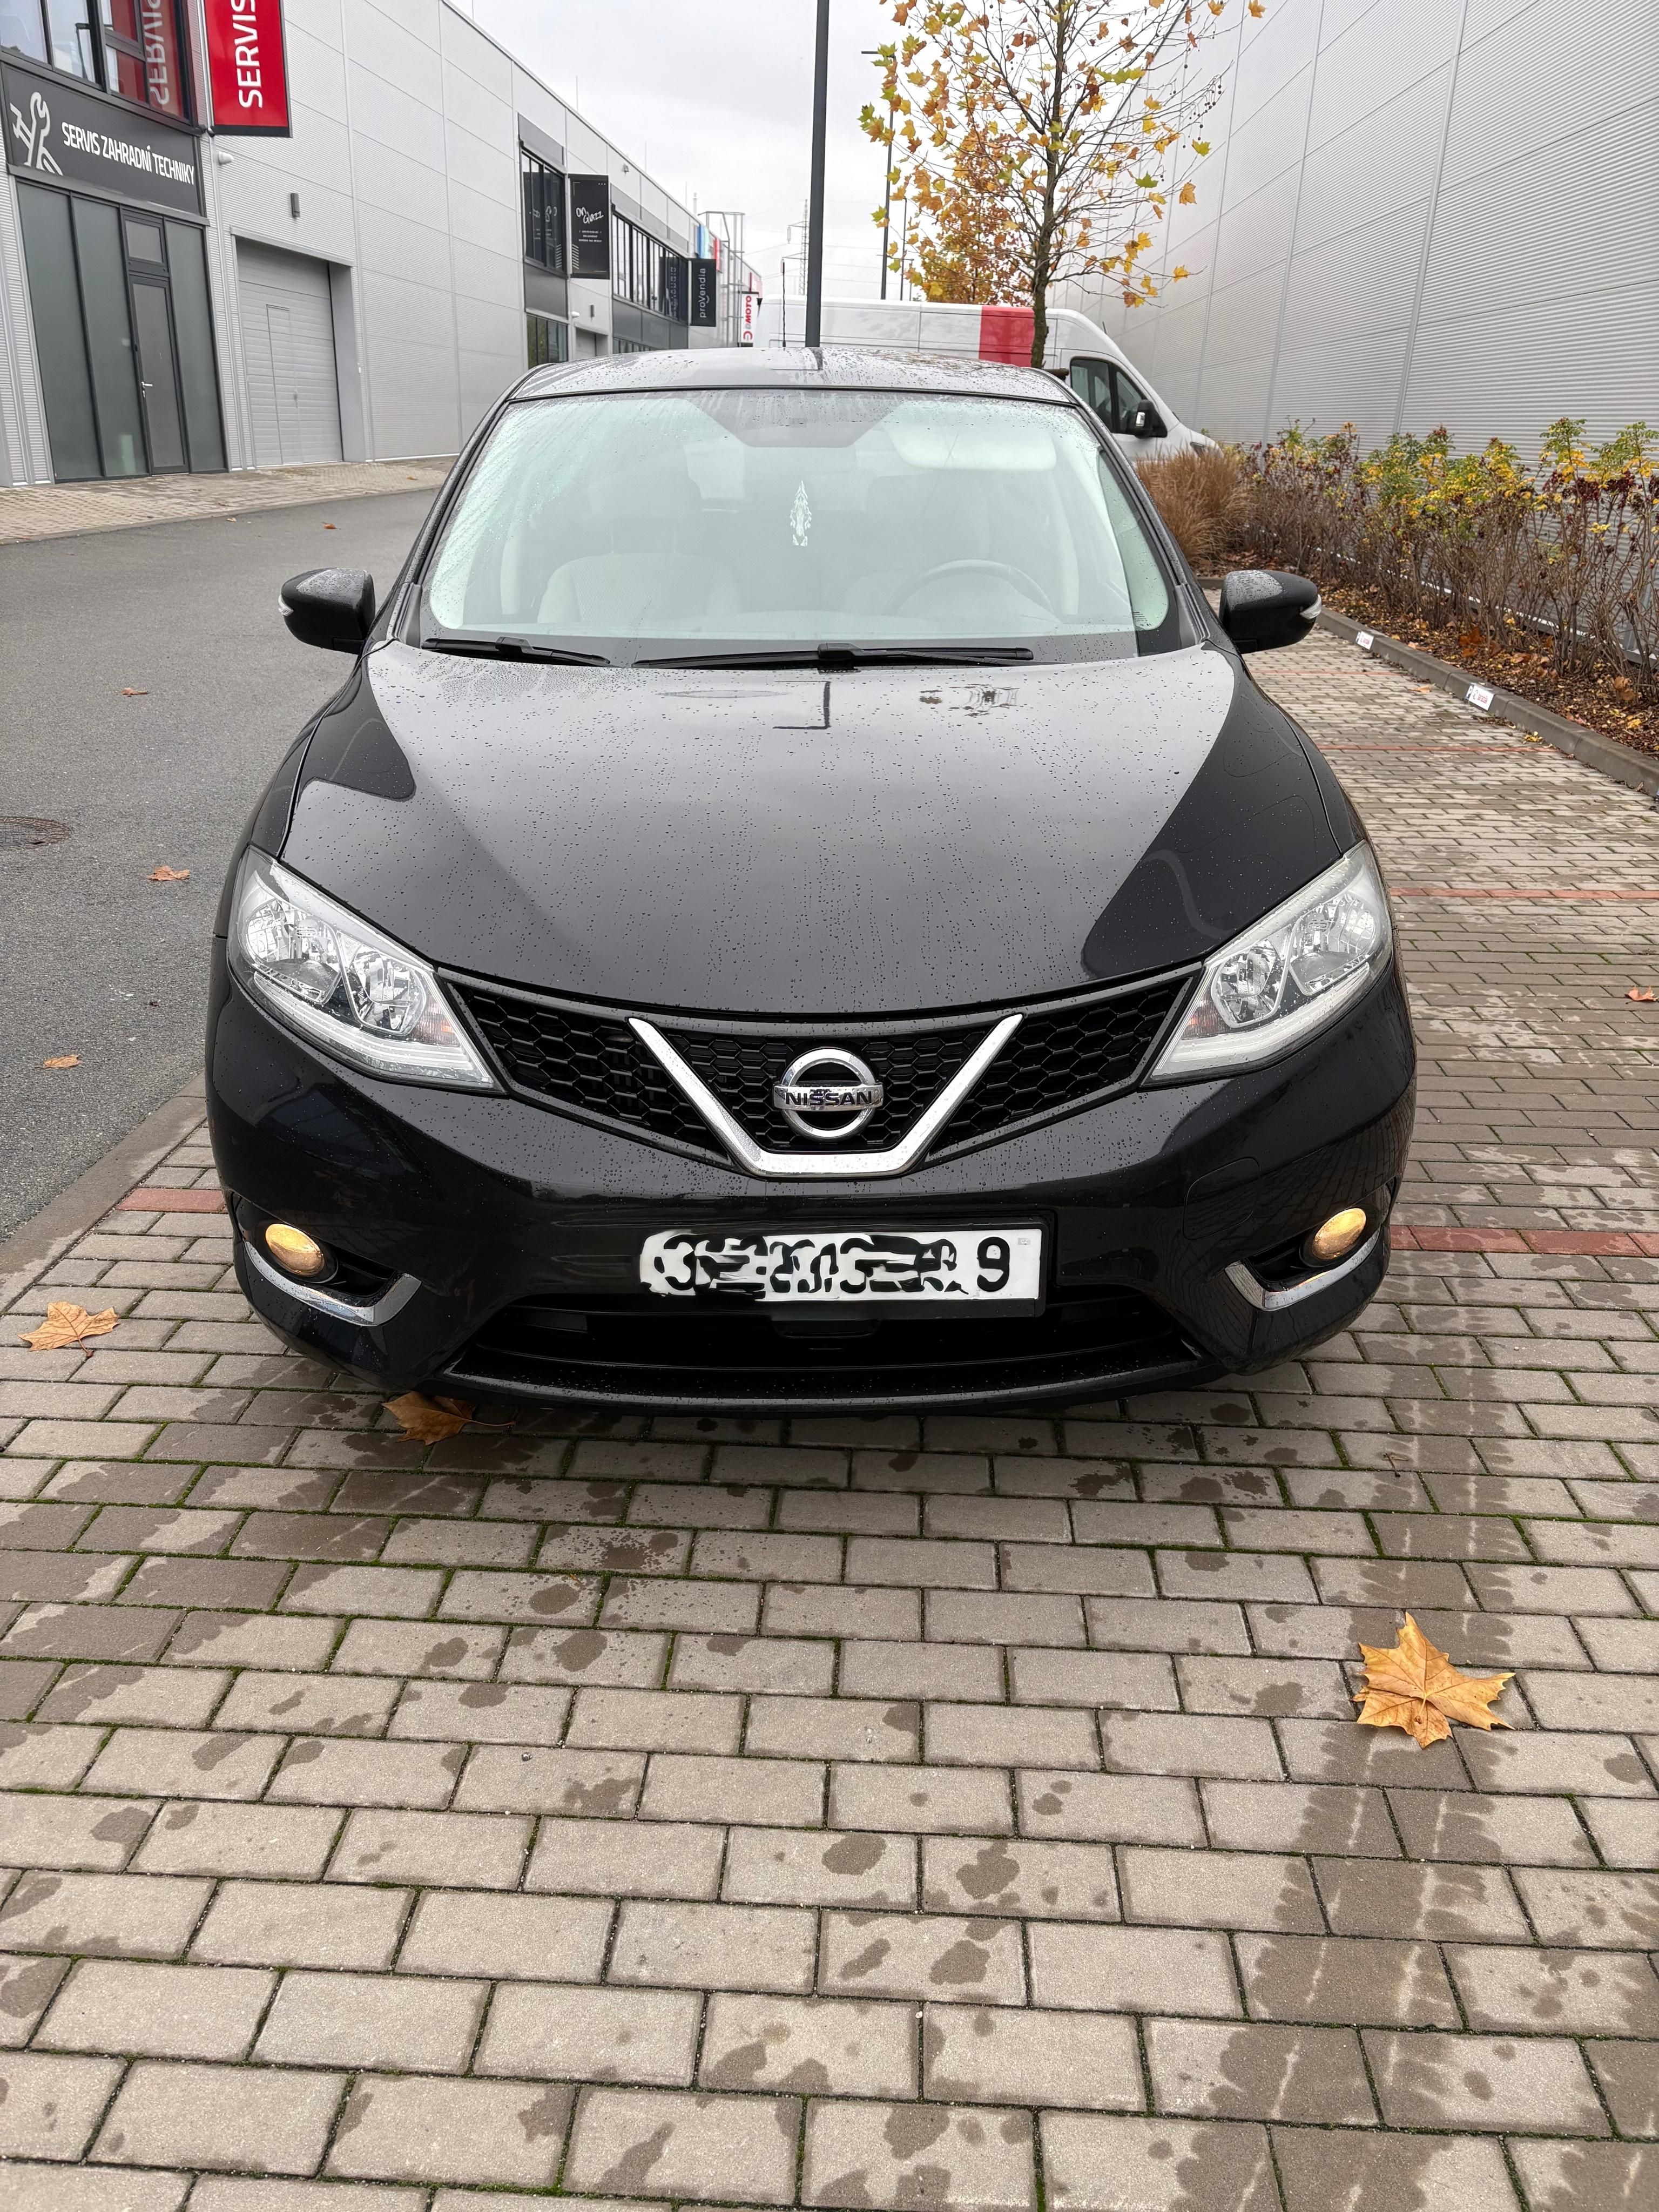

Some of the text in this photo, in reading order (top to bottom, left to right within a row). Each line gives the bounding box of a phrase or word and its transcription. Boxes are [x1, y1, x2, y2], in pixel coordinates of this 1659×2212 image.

[62, 122, 194, 185] SERVIS ZAHRADNÍ TECHNIKY
[785, 1091, 872, 1106] NISSAN
